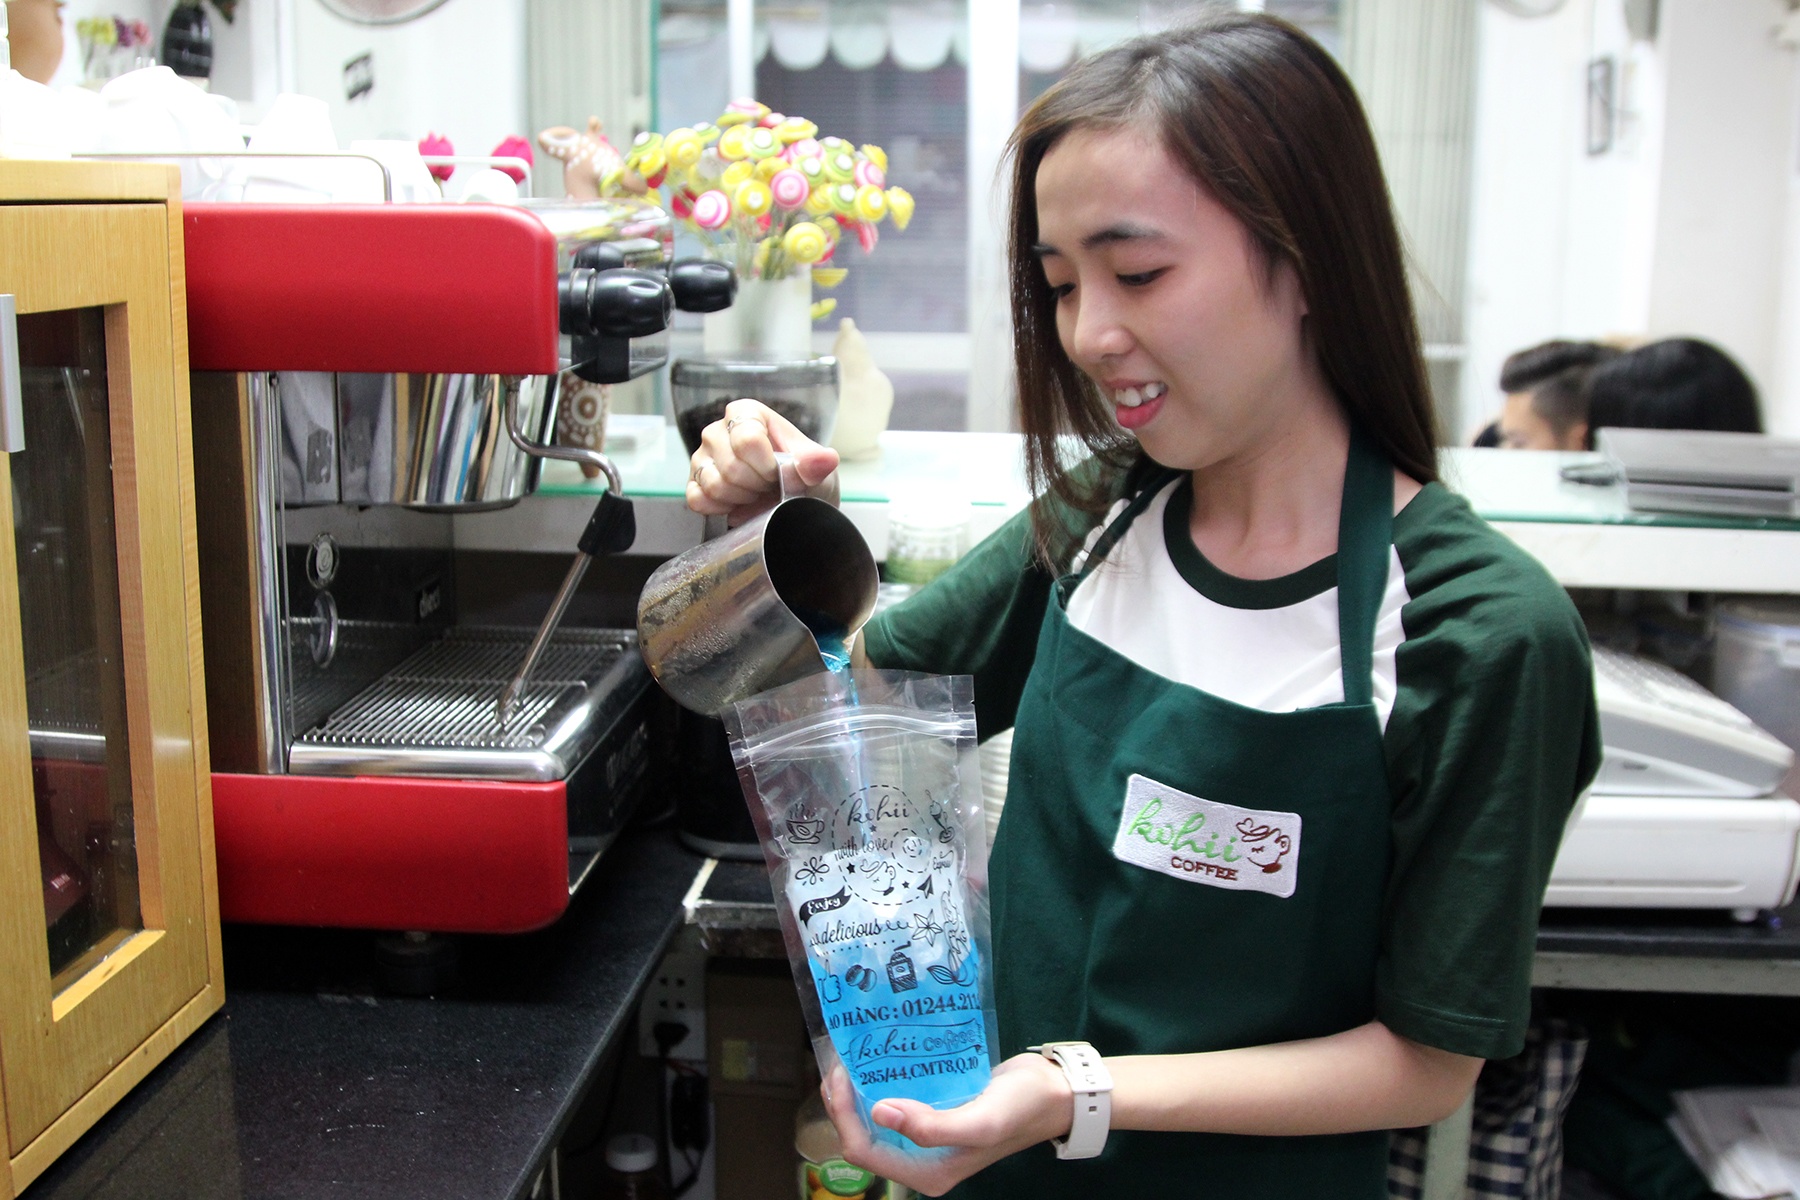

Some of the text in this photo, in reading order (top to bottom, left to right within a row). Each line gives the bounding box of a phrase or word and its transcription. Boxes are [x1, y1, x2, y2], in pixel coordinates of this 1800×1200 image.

[847, 794, 910, 826] kohii
[1126, 797, 1242, 863] kohii
[837, 836, 889, 860] with love
[1171, 856, 1239, 881] COFFEE
[807, 897, 841, 916] Enjoy
[820, 918, 882, 945] delicious
[858, 1028, 919, 1060] kohii
